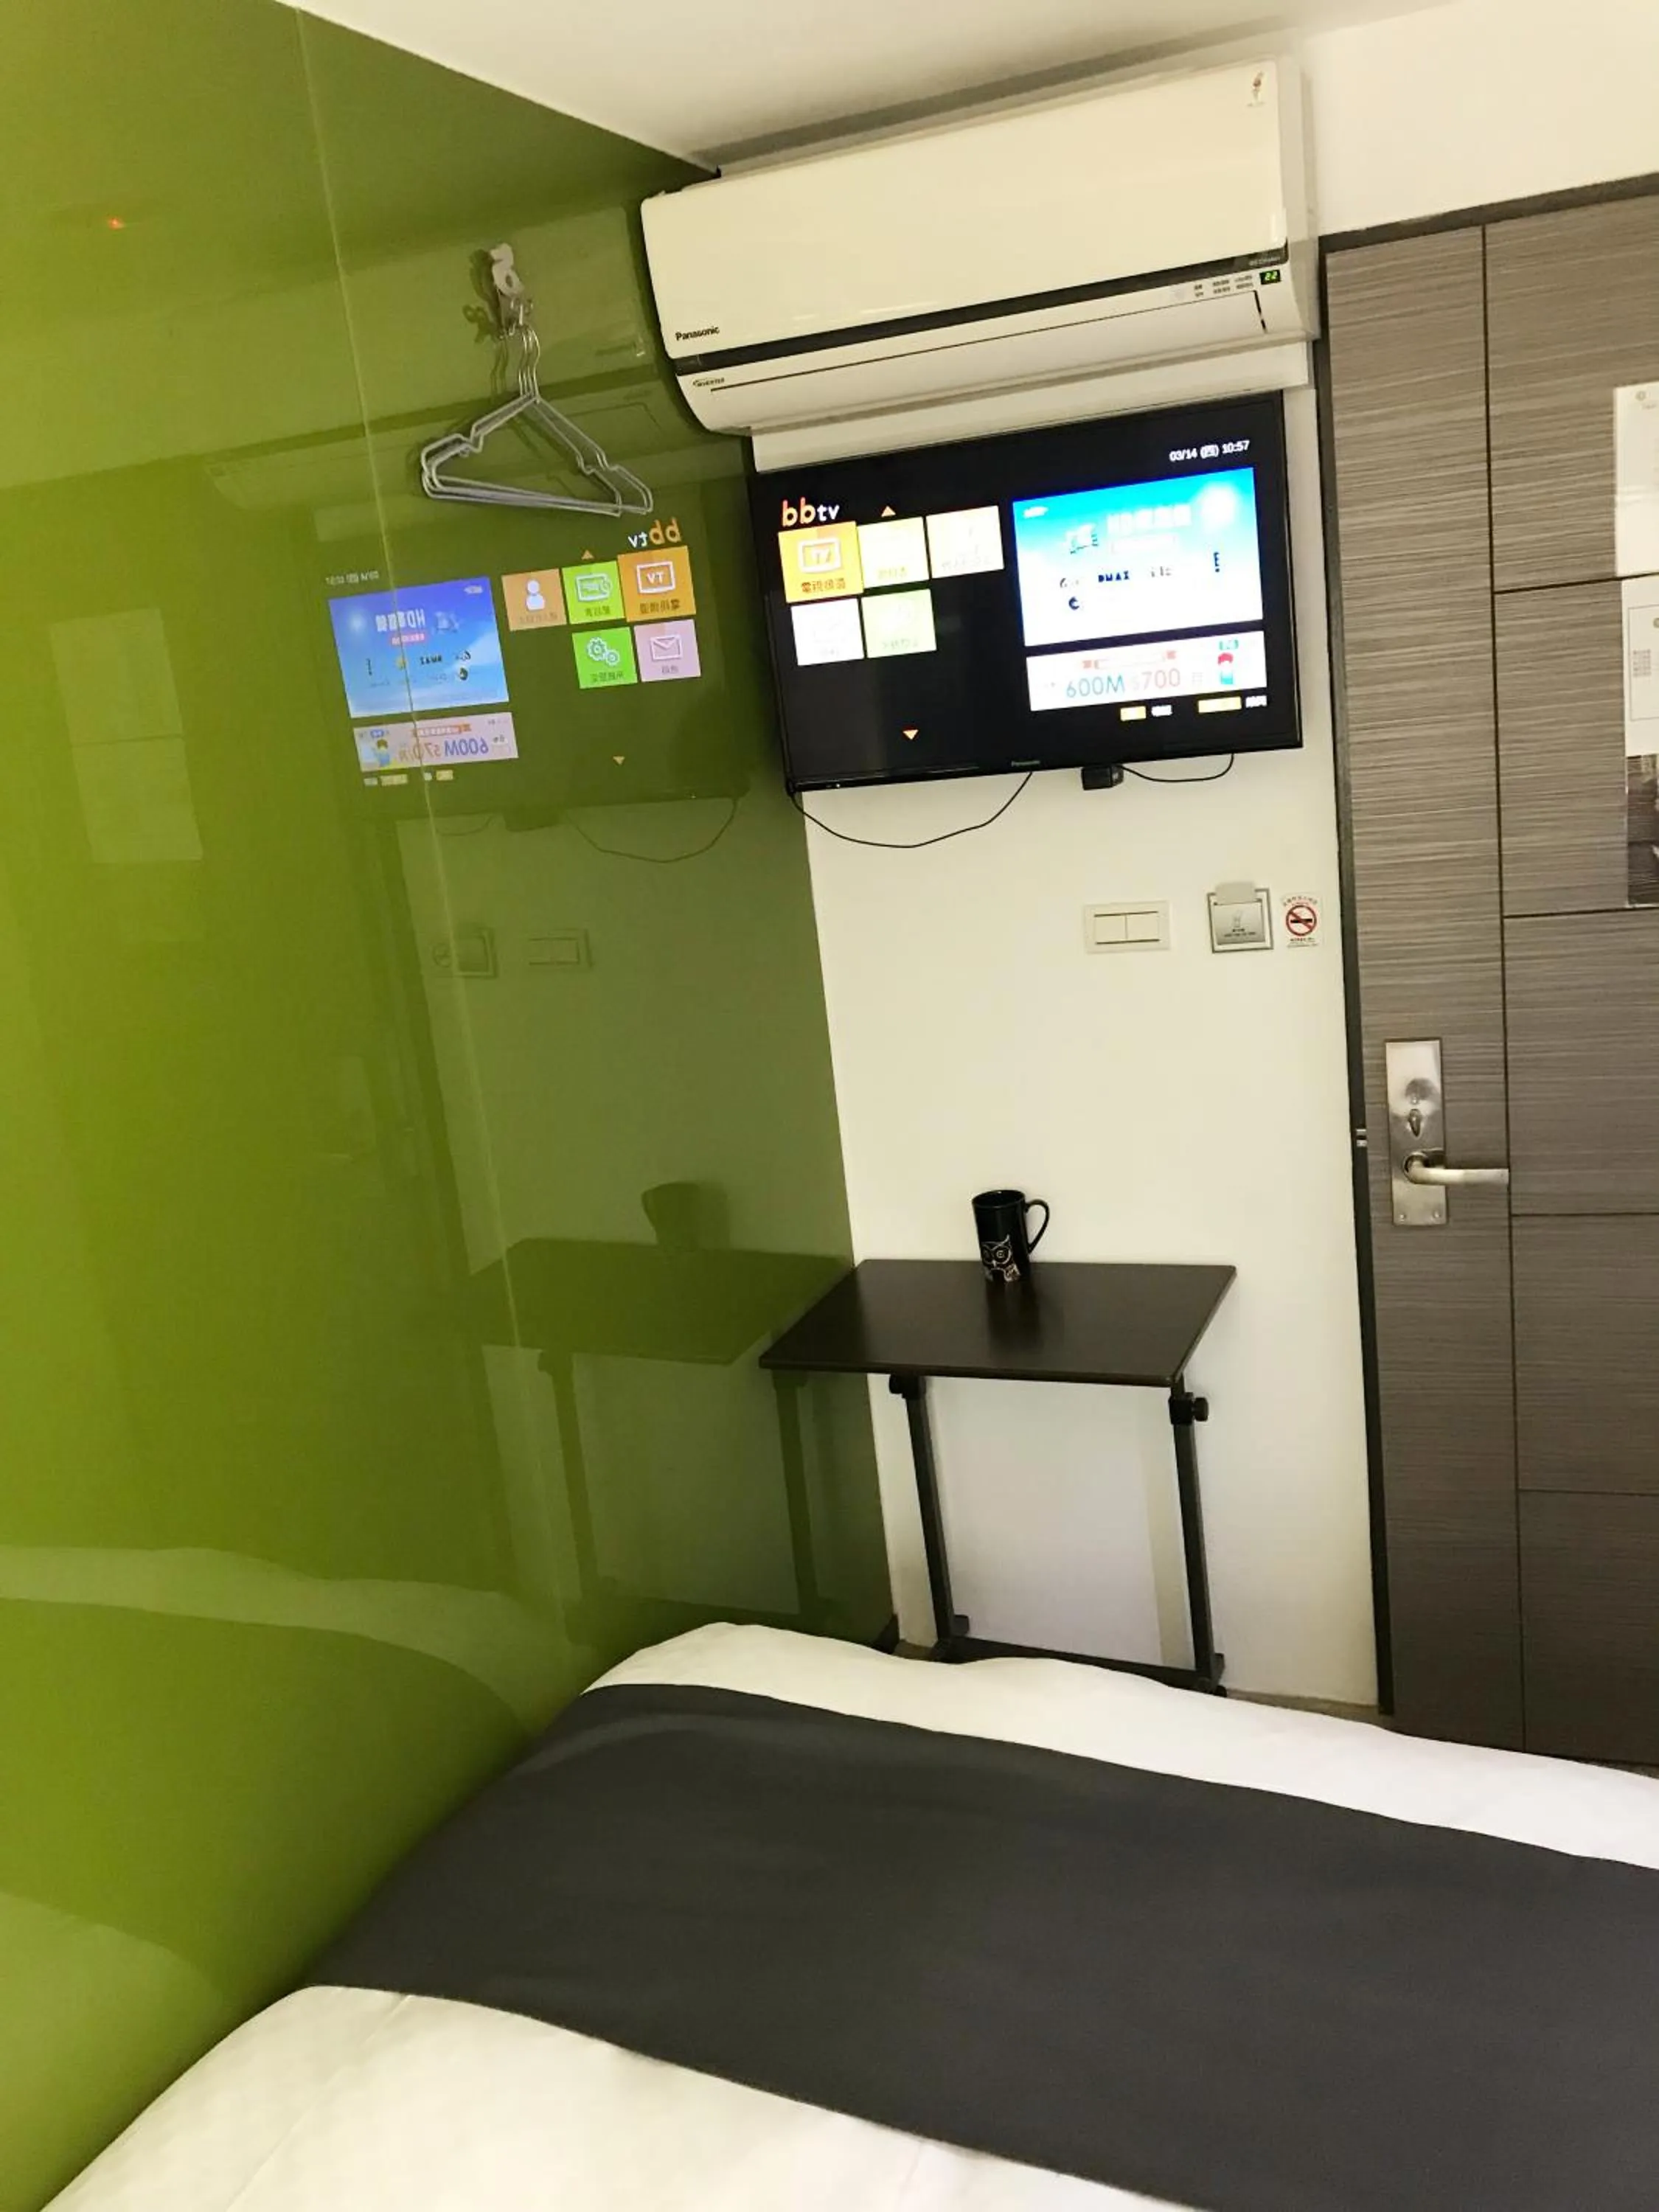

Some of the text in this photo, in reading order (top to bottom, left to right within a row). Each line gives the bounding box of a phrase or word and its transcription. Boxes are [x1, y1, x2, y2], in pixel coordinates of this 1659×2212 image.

[1265, 271, 1278, 282] 22
[675, 326, 720, 341] Panasonic
[1065, 675, 1125, 698] 600M
